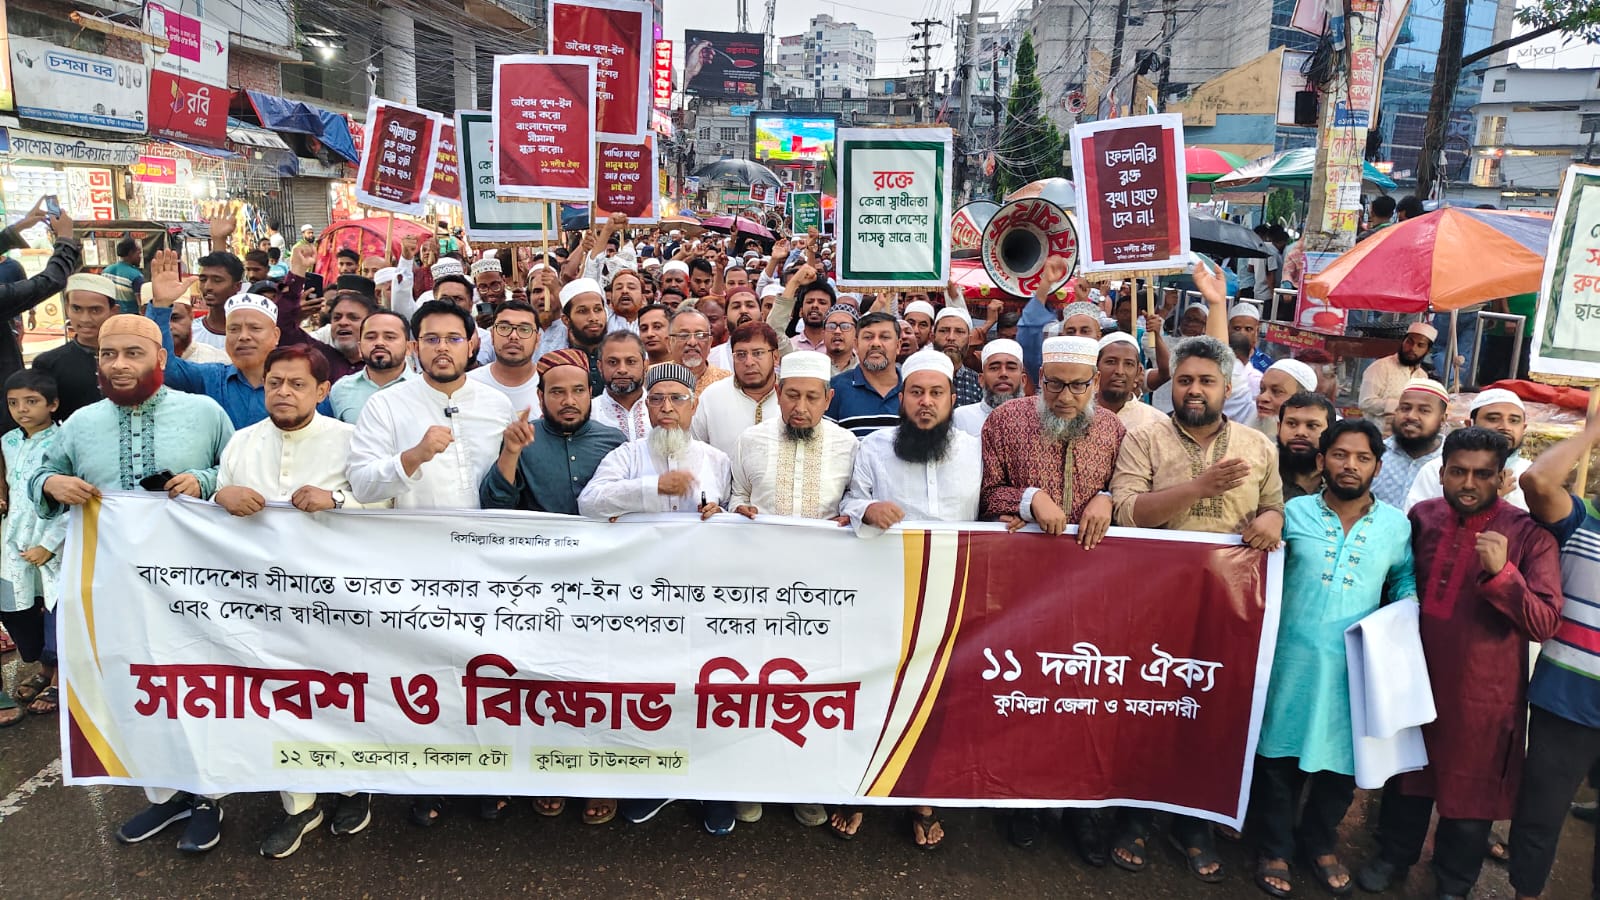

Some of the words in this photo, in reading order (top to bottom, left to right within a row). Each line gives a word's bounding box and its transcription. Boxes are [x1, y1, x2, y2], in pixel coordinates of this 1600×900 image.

[1518, 45, 1556, 57] vivo
[49, 56, 88, 73] চশমা
[93, 64, 112, 78] ঘর
[187, 87, 210, 116] রবি
[511, 96, 537, 108] অবৈধ
[539, 97, 572, 109] পুশ-ইন
[538, 110, 561, 120] করো
[388, 120, 418, 142] সীমান্তে
[515, 122, 567, 133] বাংলাদেশের
[527, 131, 555, 144] সীমানা
[11, 136, 52, 156] কাশেম
[54, 140, 112, 161] অপটিক্যাল
[1105, 142, 1157, 167] ফেলানীর
[873, 171, 915, 191] রক্তে
[1119, 169, 1141, 186] রক্ত
[859, 196, 885, 207] কেনা
[888, 192, 928, 210] স্বাধীনতা
[1105, 190, 1128, 209] বৃথা
[1131, 188, 1158, 206] যেতে
[858, 214, 892, 225] কোনো
[895, 214, 928, 226] দেশের
[1112, 210, 1133, 228] দেব
[1136, 208, 1155, 226] না!
[858, 232, 885, 248] দাসত্ব
[888, 232, 911, 243] মানে
[914, 232, 927, 243] না!
[450, 531, 505, 546] বিসমিল্লাহির
[508, 534, 551, 547] রাহমানির
[554, 536, 580, 548] রাহিম
[137, 565, 259, 590] বাংলাদেশের
[265, 566, 336, 595] সীমান্তে
[343, 576, 404, 596] ভারত
[411, 578, 480, 599] সরকার
[487, 574, 544, 607] কর্তৃক
[550, 576, 621, 604] পুশ-ইন
[628, 586, 644, 600] ও
[650, 577, 706, 602] সীমান্ত
[712, 585, 769, 605] হত্যার
[775, 581, 858, 607] প্রতিবাদে
[169, 600, 212, 620] এবং
[219, 601, 282, 623] দেশের
[288, 600, 372, 627] স্বাধীনতা
[380, 604, 488, 637] সার্বভৌমত্ব
[495, 605, 563, 634] বিরোধী
[570, 614, 686, 636] অপতৎপরতা
[706, 616, 758, 637] বন্ধের
[764, 611, 831, 637] দাবীতে
[981, 647, 1022, 682] ১১
[1036, 641, 1132, 687] দলীয়
[1140, 643, 1225, 692] ঐক্য
[130, 663, 369, 723] সমাবেশ
[390, 673, 440, 726] ও
[462, 653, 676, 731] বিক্ষোভ
[694, 656, 862, 749] মিছিল
[992, 690, 1050, 717] কুমিল্লা
[1054, 697, 1099, 716] জেলা
[1104, 700, 1118, 714] ও
[1123, 695, 1202, 720] মহানগরী
[280, 749, 302, 766] ১২
[423, 748, 471, 767] বিকাল
[478, 748, 509, 767] ৫টা
[535, 750, 583, 771] কুমিল্লা
[588, 751, 651, 769] টাউনহল
[656, 751, 684, 769] মাঠ
